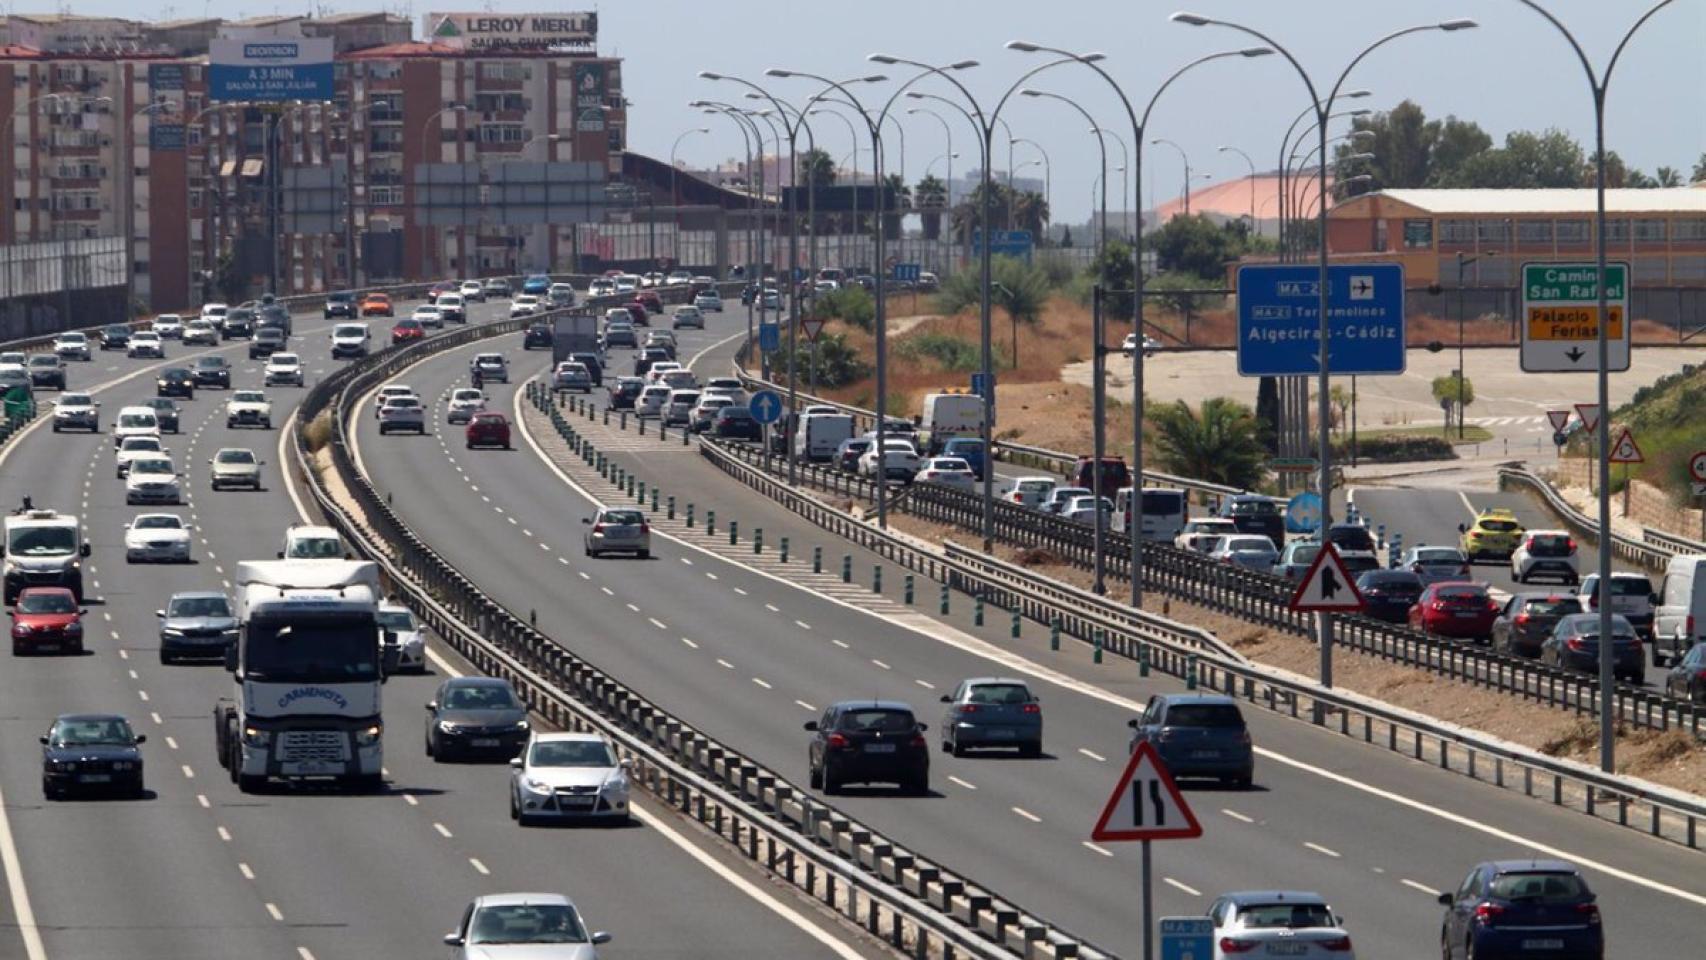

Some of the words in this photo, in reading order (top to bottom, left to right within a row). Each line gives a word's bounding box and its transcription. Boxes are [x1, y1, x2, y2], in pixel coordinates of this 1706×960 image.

[467, 18, 525, 33] LEROY
[532, 18, 597, 33] MERLI
[248, 68, 258, 80] A
[259, 68, 268, 80] 3
[270, 68, 294, 80] MIN
[1544, 269, 1600, 283] Camin
[1530, 284, 1561, 298] San
[1569, 284, 1622, 298] Rafel
[1296, 306, 1386, 317] Toremolinos
[1531, 309, 1590, 322] Palacio
[1551, 325, 1599, 338] Ferias
[1163, 921, 1211, 932] MA-20
